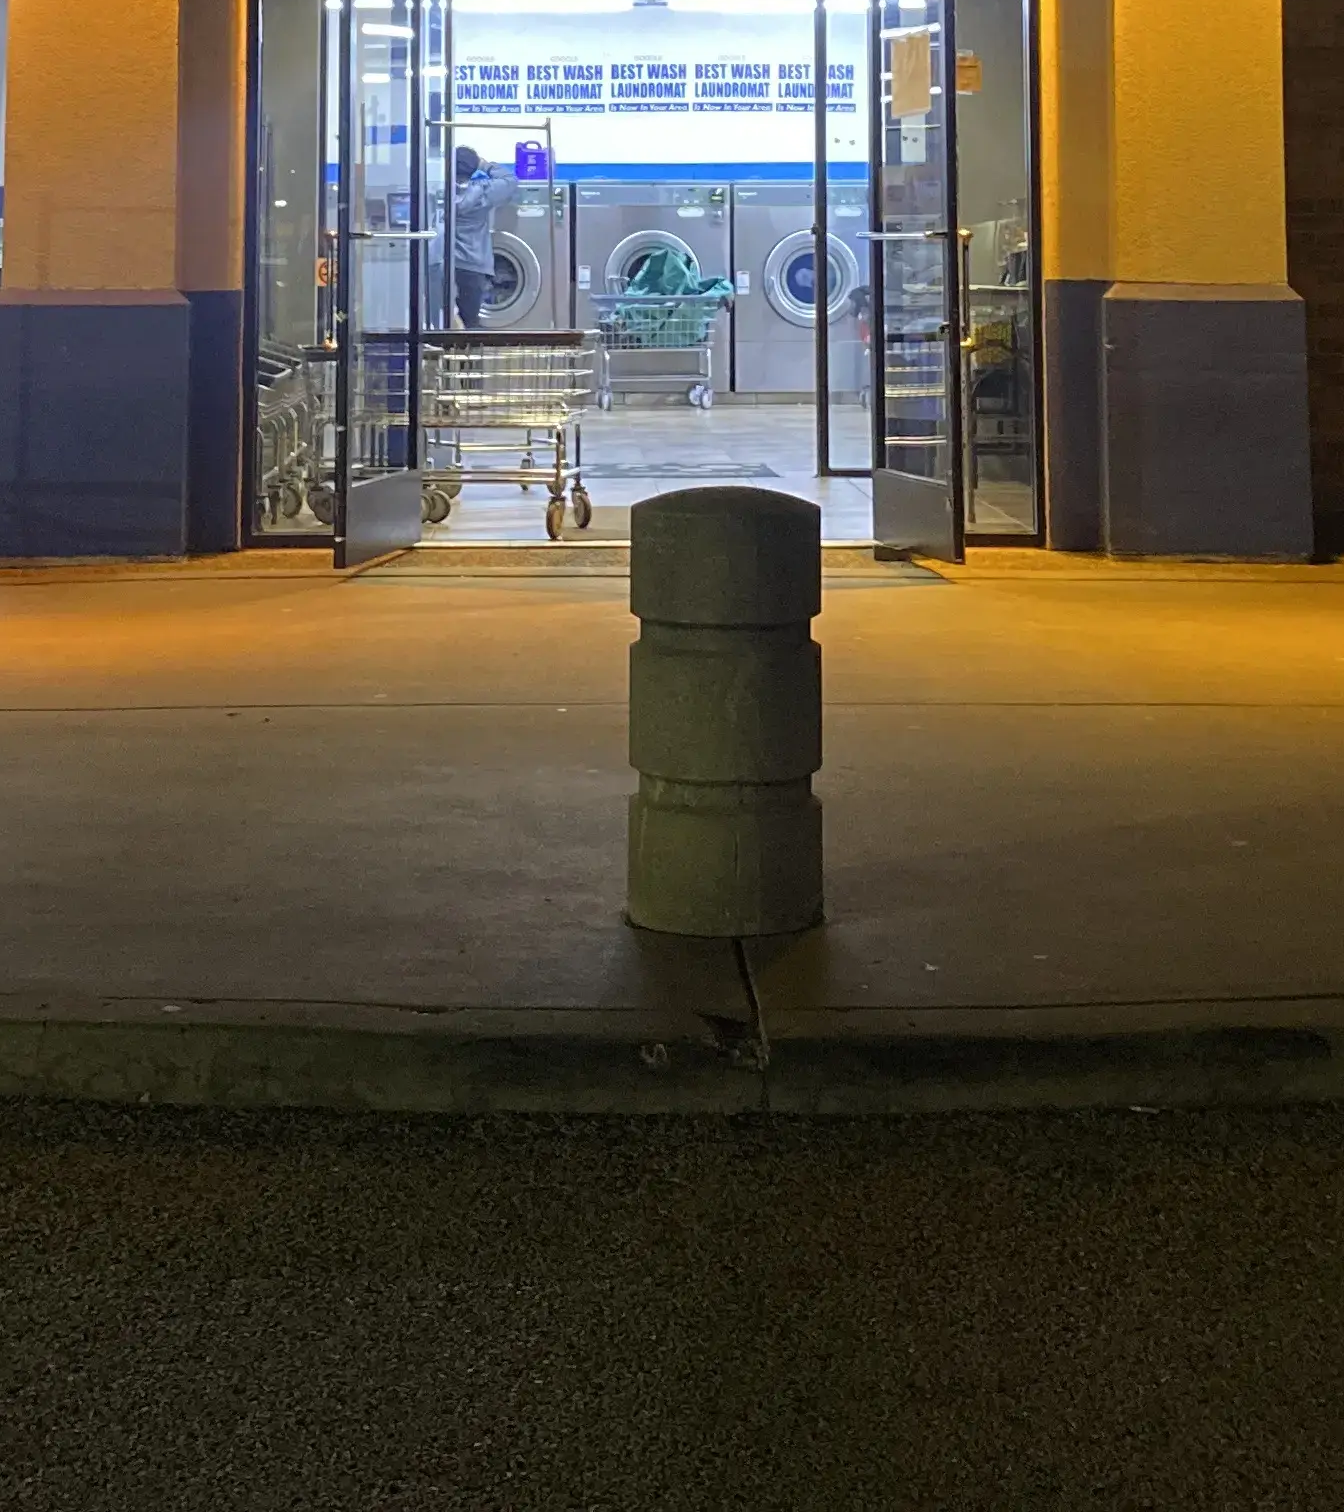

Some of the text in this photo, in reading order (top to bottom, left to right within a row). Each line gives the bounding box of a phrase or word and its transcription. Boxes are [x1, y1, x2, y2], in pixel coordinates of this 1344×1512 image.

[455, 65, 520, 81] EST WASH
[527, 65, 603, 81] BEST WASH
[610, 63, 687, 80] BEST WASH
[694, 63, 771, 80] BEST WASH
[778, 64, 854, 80] BEST ASH
[457, 83, 519, 99] UNDROMAT
[526, 83, 603, 100] LAUNDROMAT
[610, 82, 687, 98] LAUNDROMAT
[694, 82, 770, 98] LAUNDROMAT
[778, 82, 854, 99] LAUNDOMAT
[733, 103, 751, 111] Your
